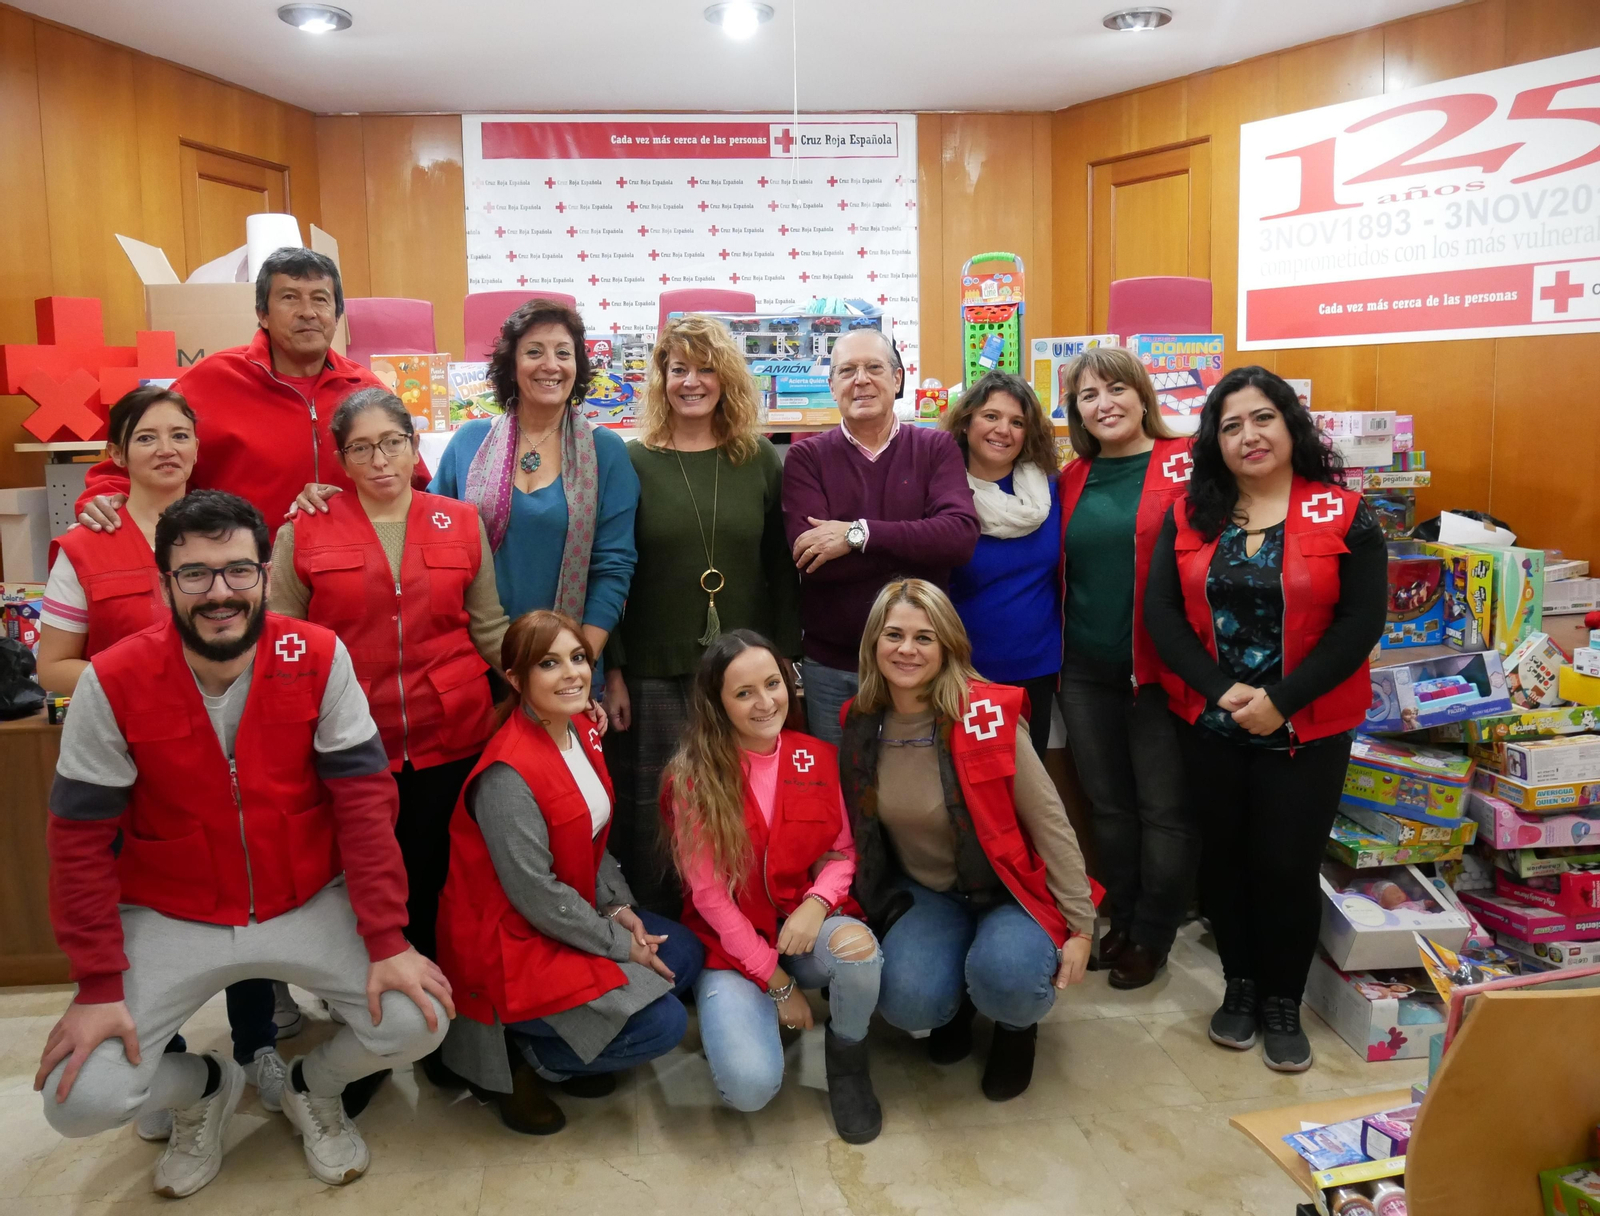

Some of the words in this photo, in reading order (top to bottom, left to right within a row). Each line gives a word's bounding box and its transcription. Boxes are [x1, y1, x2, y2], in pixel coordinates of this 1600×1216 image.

[611, 135, 632, 144] Cada
[653, 135, 670, 144] más
[700, 135, 711, 144] de
[714, 135, 726, 144] las
[730, 137, 767, 146] personas
[801, 135, 822, 145] Cruz
[826, 135, 846, 147] Roja
[850, 134, 892, 147] Española
[1260, 74, 1600, 221] 125
[1377, 180, 1486, 204] años
[1259, 208, 1411, 252] 3NOV1893
[1445, 184, 1600, 230] 3NOV20
[1260, 243, 1389, 282] comprometidos
[1394, 243, 1426, 263] con
[1433, 235, 1458, 259] los
[1466, 230, 1505, 257] más
[1319, 303, 1343, 315] Cada
[1347, 302, 1363, 313] vez
[1367, 298, 1388, 312] más
[1393, 297, 1422, 310] cerca
[1426, 295, 1439, 306] de
[1444, 293, 1460, 306] las
[1465, 290, 1517, 308] personas
[1151, 339, 1222, 354] DOMINÓ
[752, 360, 812, 374] CAMIÓN
[1167, 355, 1221, 370] COLORES
[1536, 788, 1574, 797] AVERIGUA
[1535, 798, 1558, 806] QUIEN
